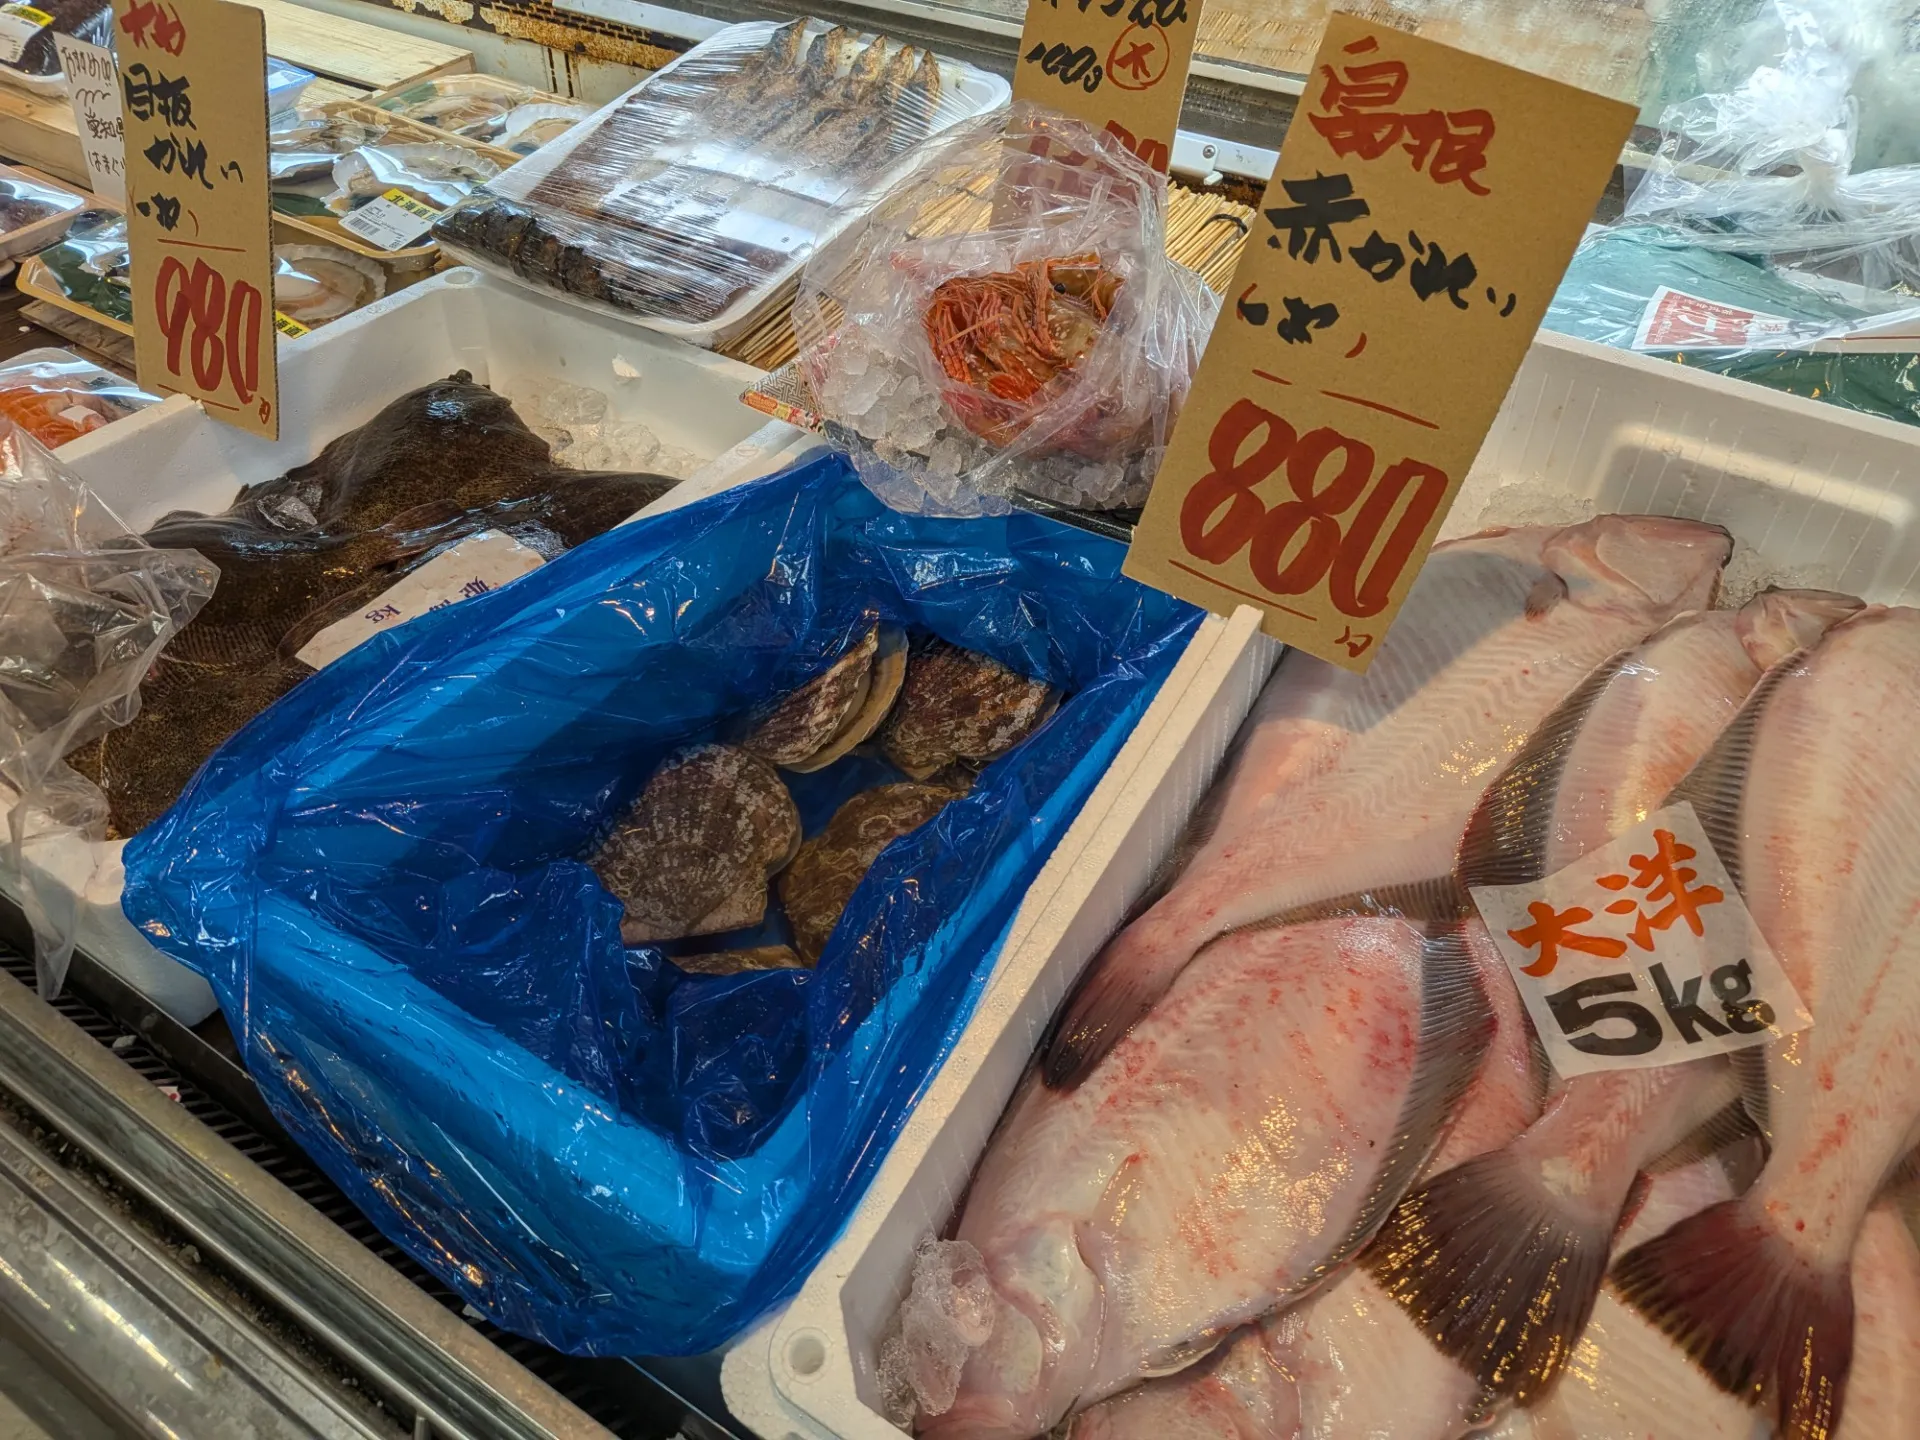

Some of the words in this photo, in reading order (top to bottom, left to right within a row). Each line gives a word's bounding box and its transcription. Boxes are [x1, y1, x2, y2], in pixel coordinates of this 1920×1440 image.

[1180, 397, 1449, 618] 880
[1506, 828, 1725, 977] 大洋
[1543, 957, 1777, 1057] 5kg
